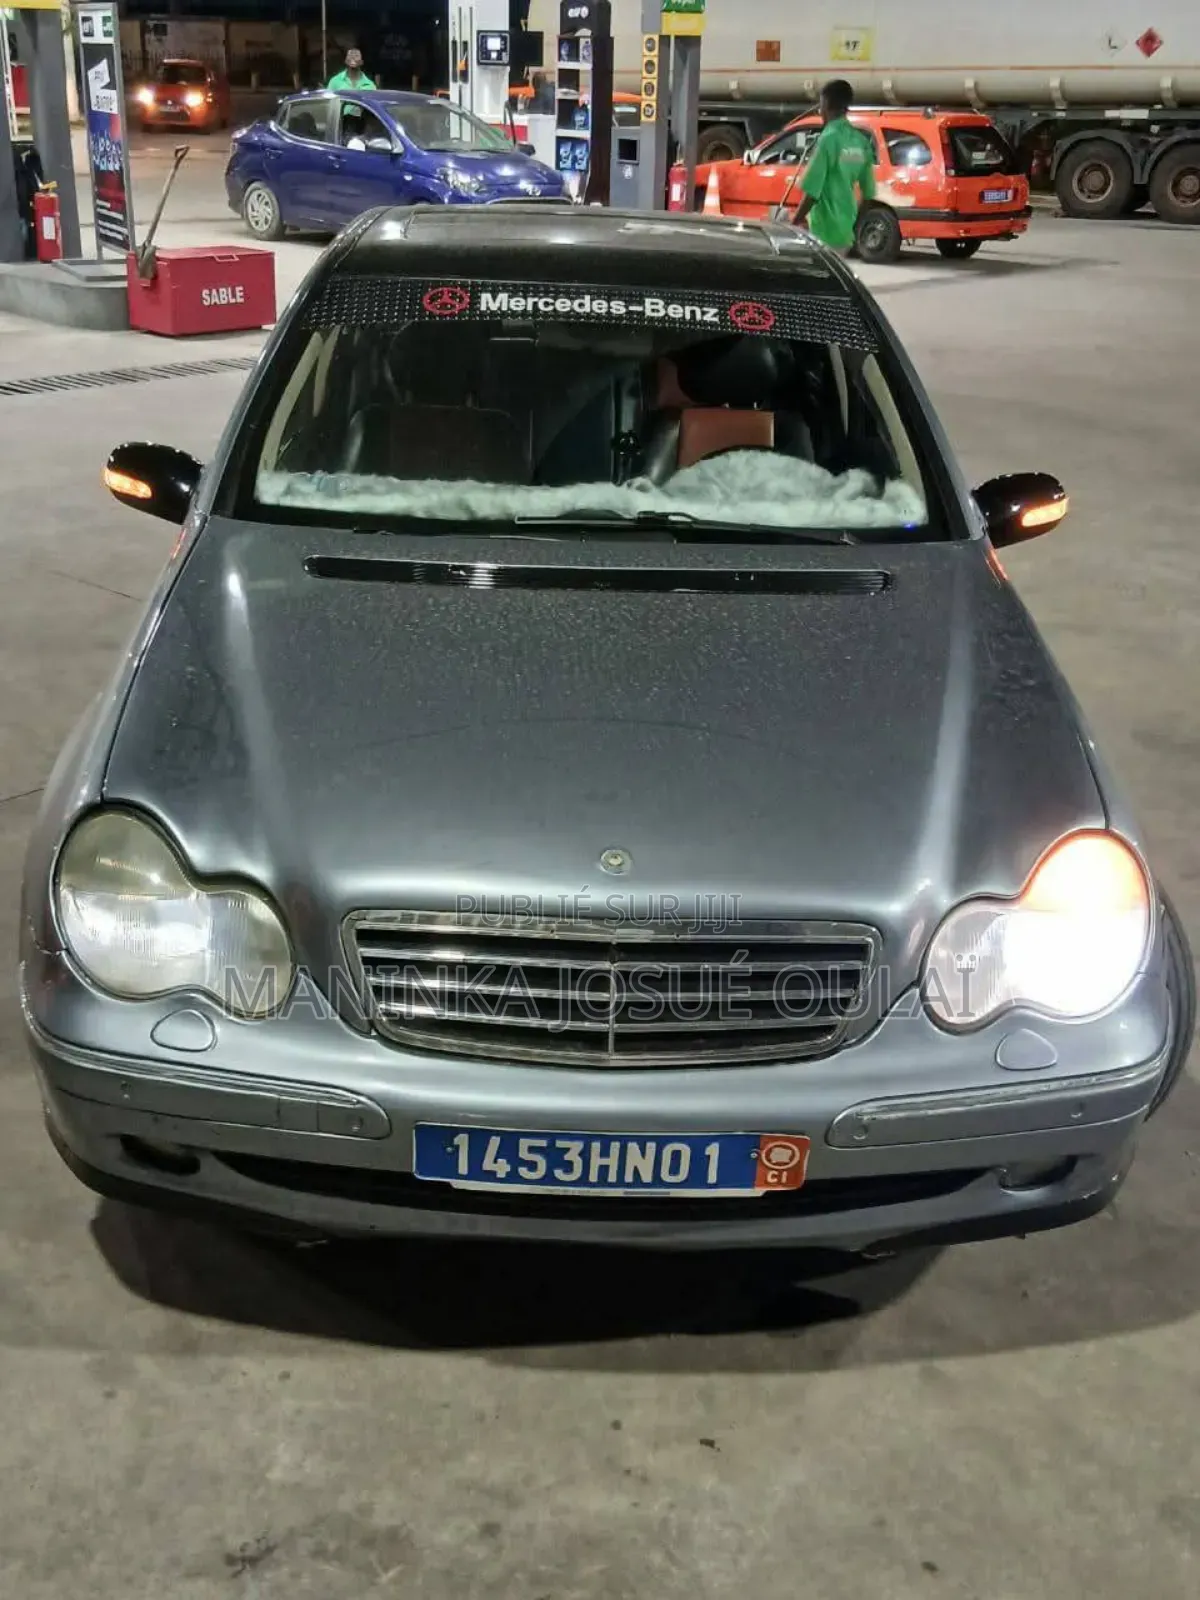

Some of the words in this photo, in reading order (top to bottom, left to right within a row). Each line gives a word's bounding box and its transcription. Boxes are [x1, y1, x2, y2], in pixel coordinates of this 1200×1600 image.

[202, 286, 244, 306] SABLE
[479, 292, 720, 323] Mercedes-Benz
[452, 1133, 720, 1184] 1453HN01
